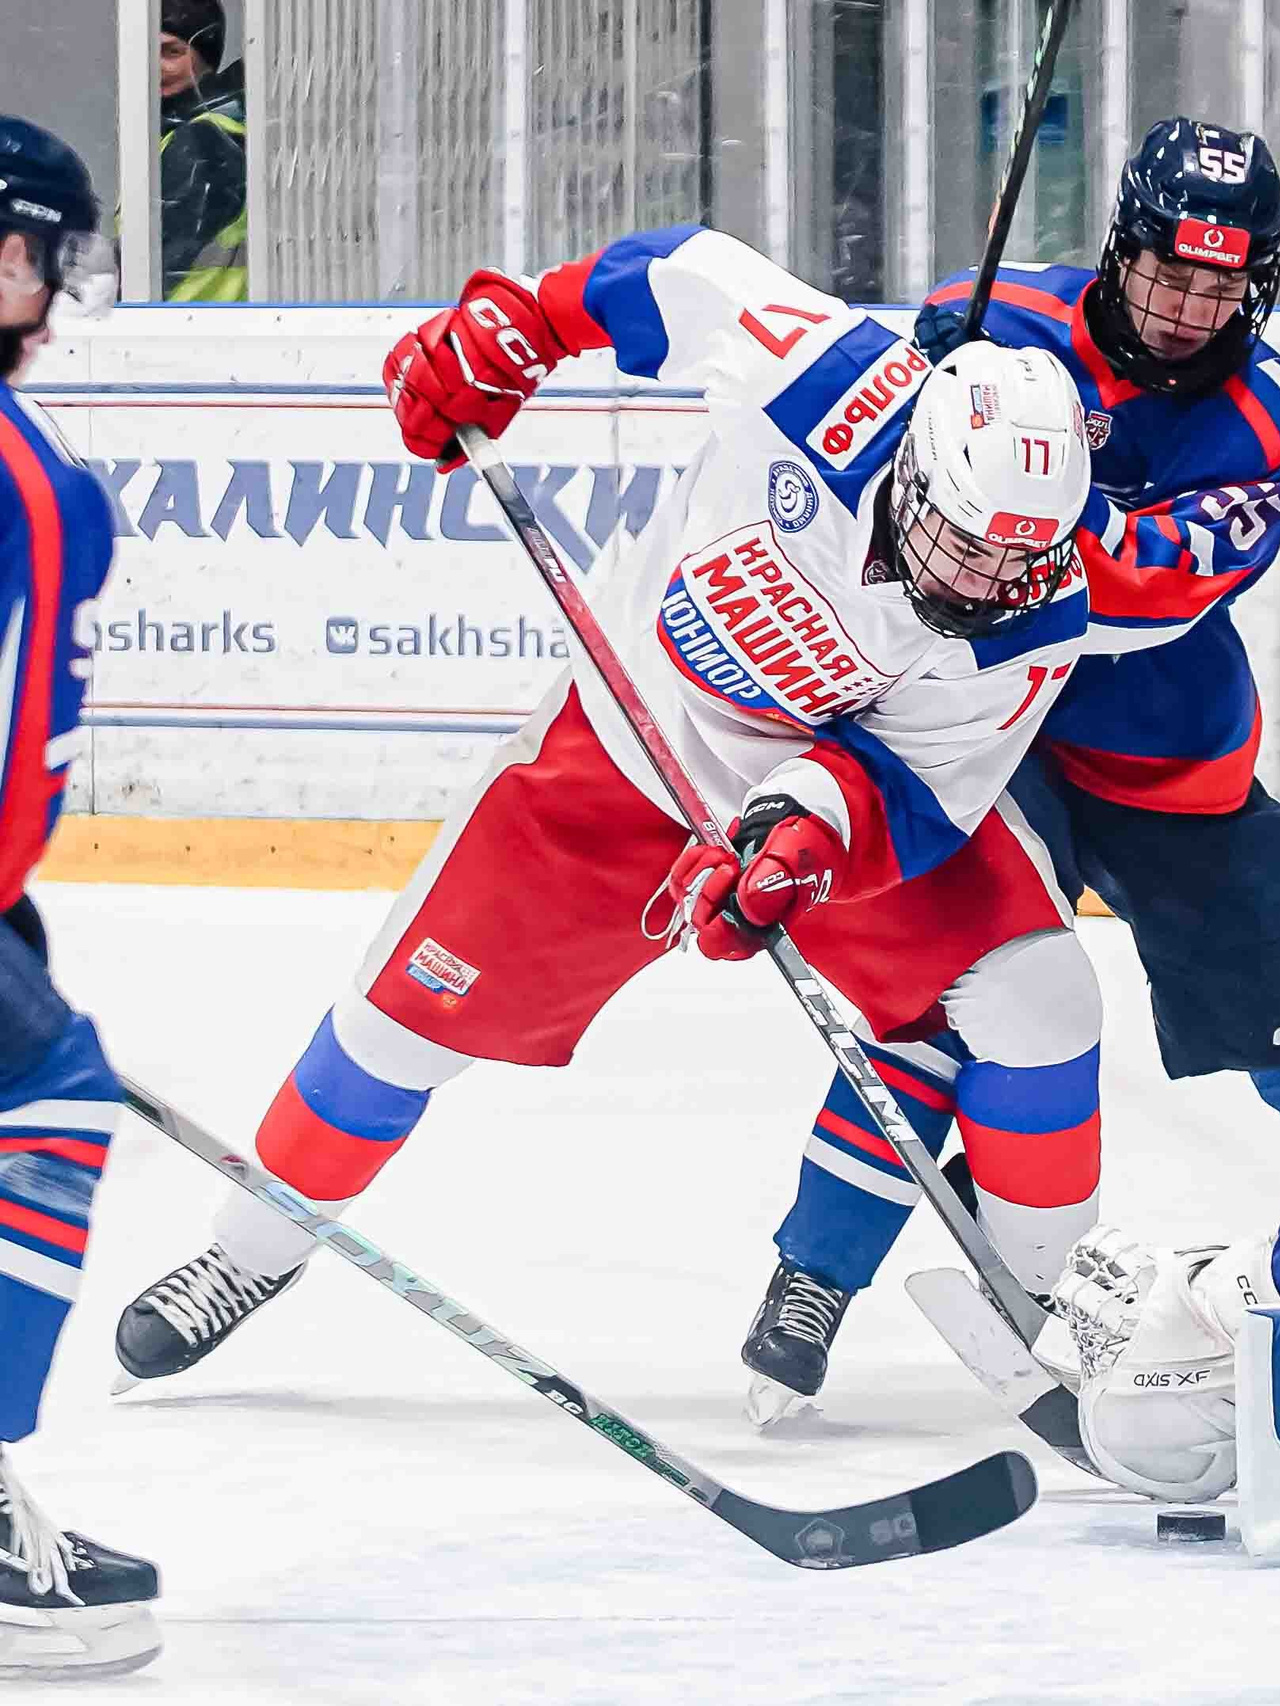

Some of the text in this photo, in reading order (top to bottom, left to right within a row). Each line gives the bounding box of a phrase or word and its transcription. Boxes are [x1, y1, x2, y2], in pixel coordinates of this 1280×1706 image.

[1200, 147, 1247, 184] 55
[1178, 243, 1241, 263] OLIMPBET
[822, 346, 928, 455] РОЛЬФ
[1021, 437, 1050, 475] 17
[88, 458, 690, 574] ХАЛИНСКИ
[662, 589, 762, 700] ЮНИОР
[734, 537, 859, 682] КРАСНАЯ
[744, 801, 786, 820] CCM
[413, 949, 468, 990] МАШИНА
[795, 978, 919, 1141] CCM
